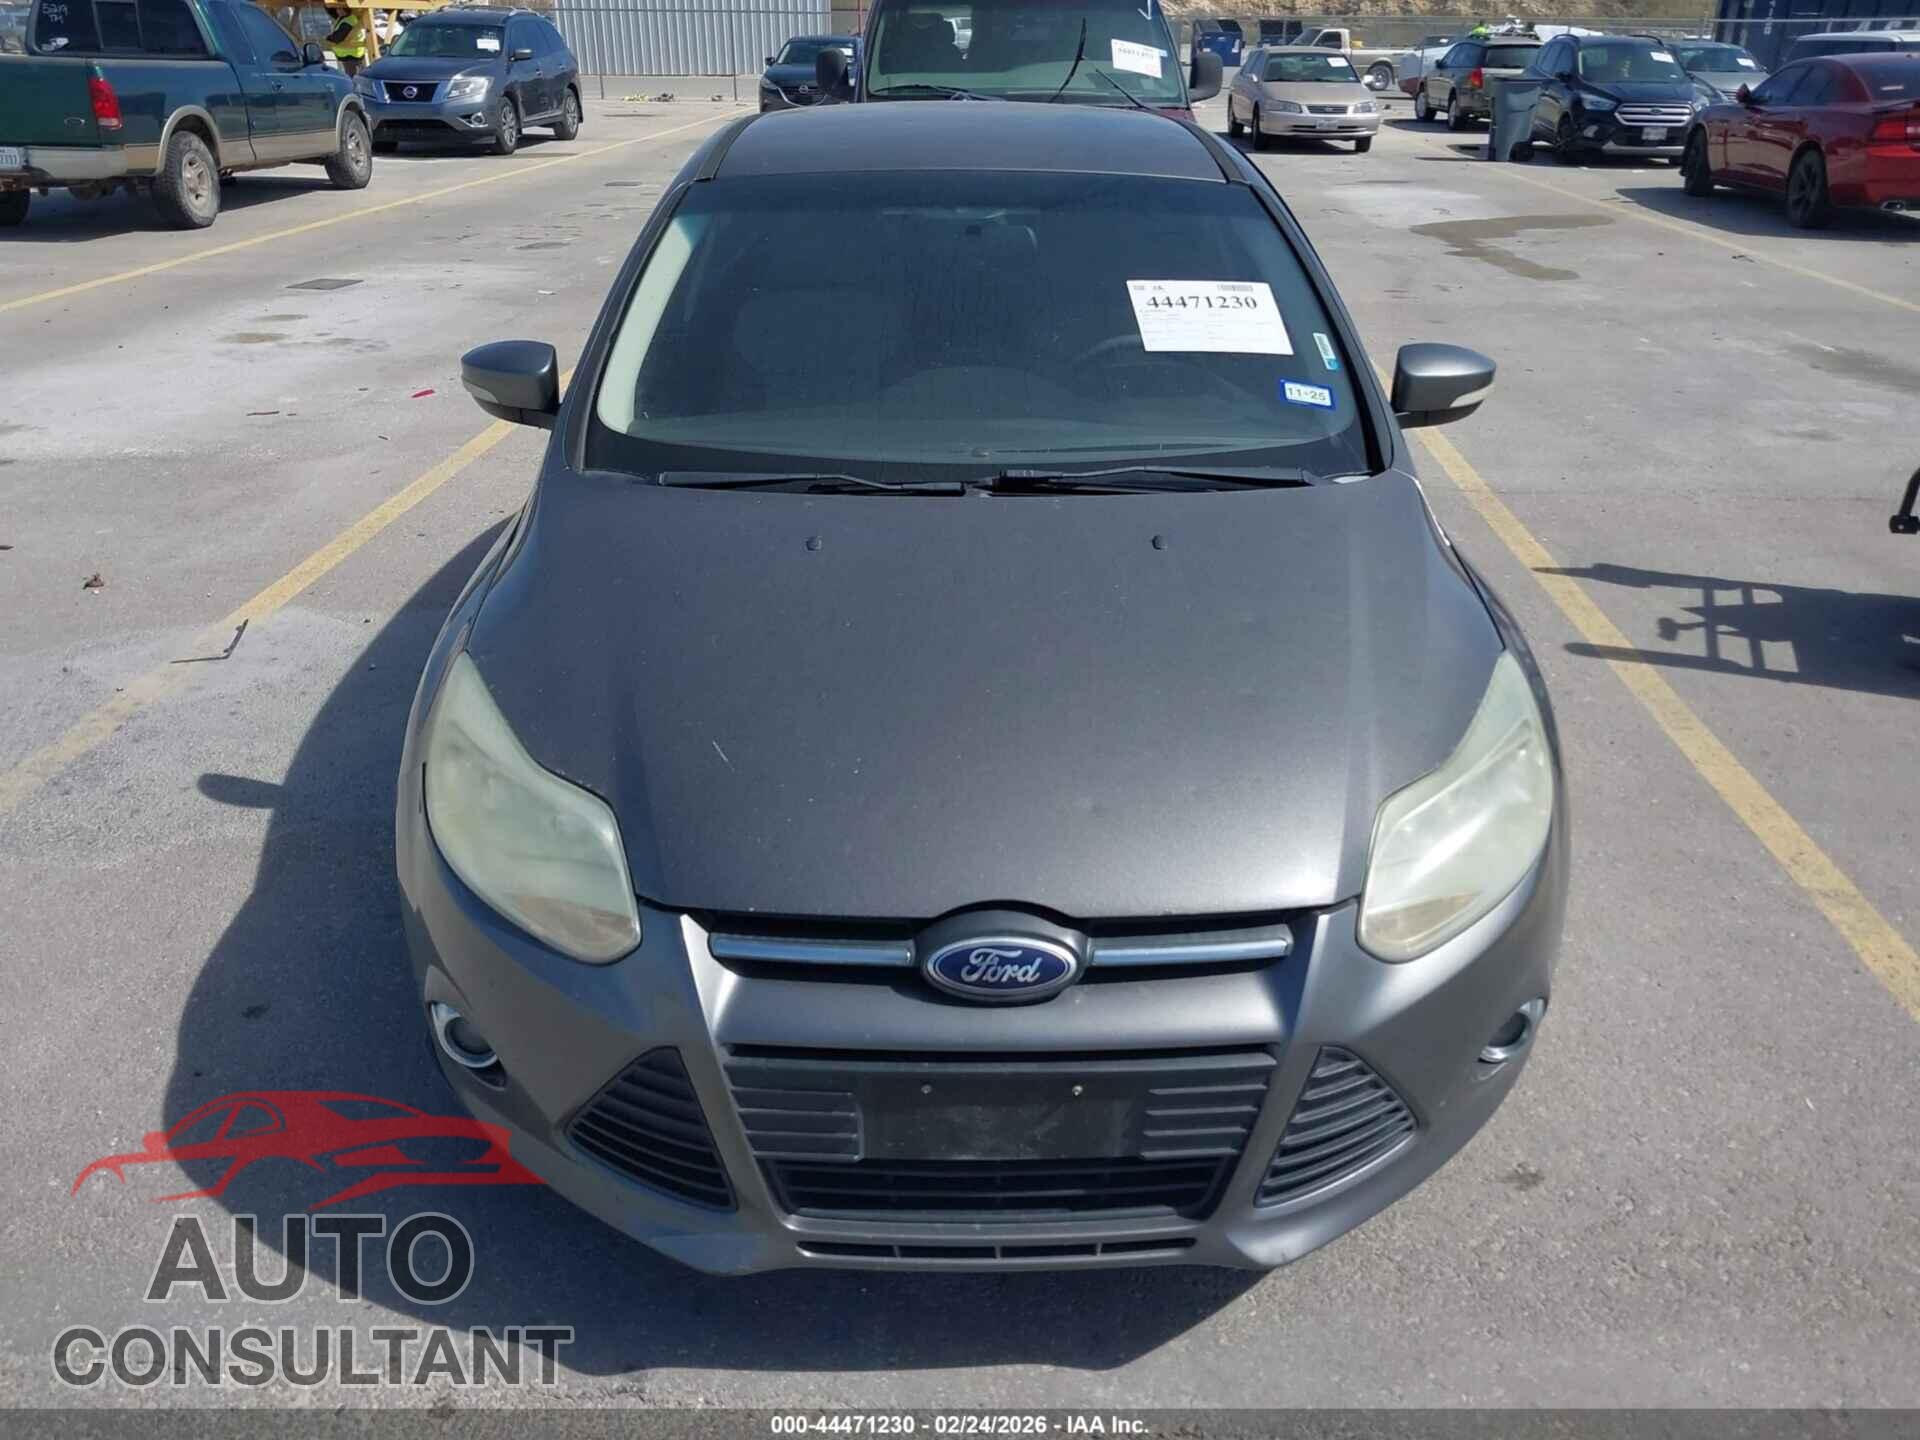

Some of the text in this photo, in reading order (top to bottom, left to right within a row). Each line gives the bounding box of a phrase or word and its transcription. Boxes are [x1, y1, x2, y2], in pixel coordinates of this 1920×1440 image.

[1146, 296, 1257, 309] 44471230
[1287, 387, 1326, 401] 11-25
[960, 948, 1041, 983] Ford
